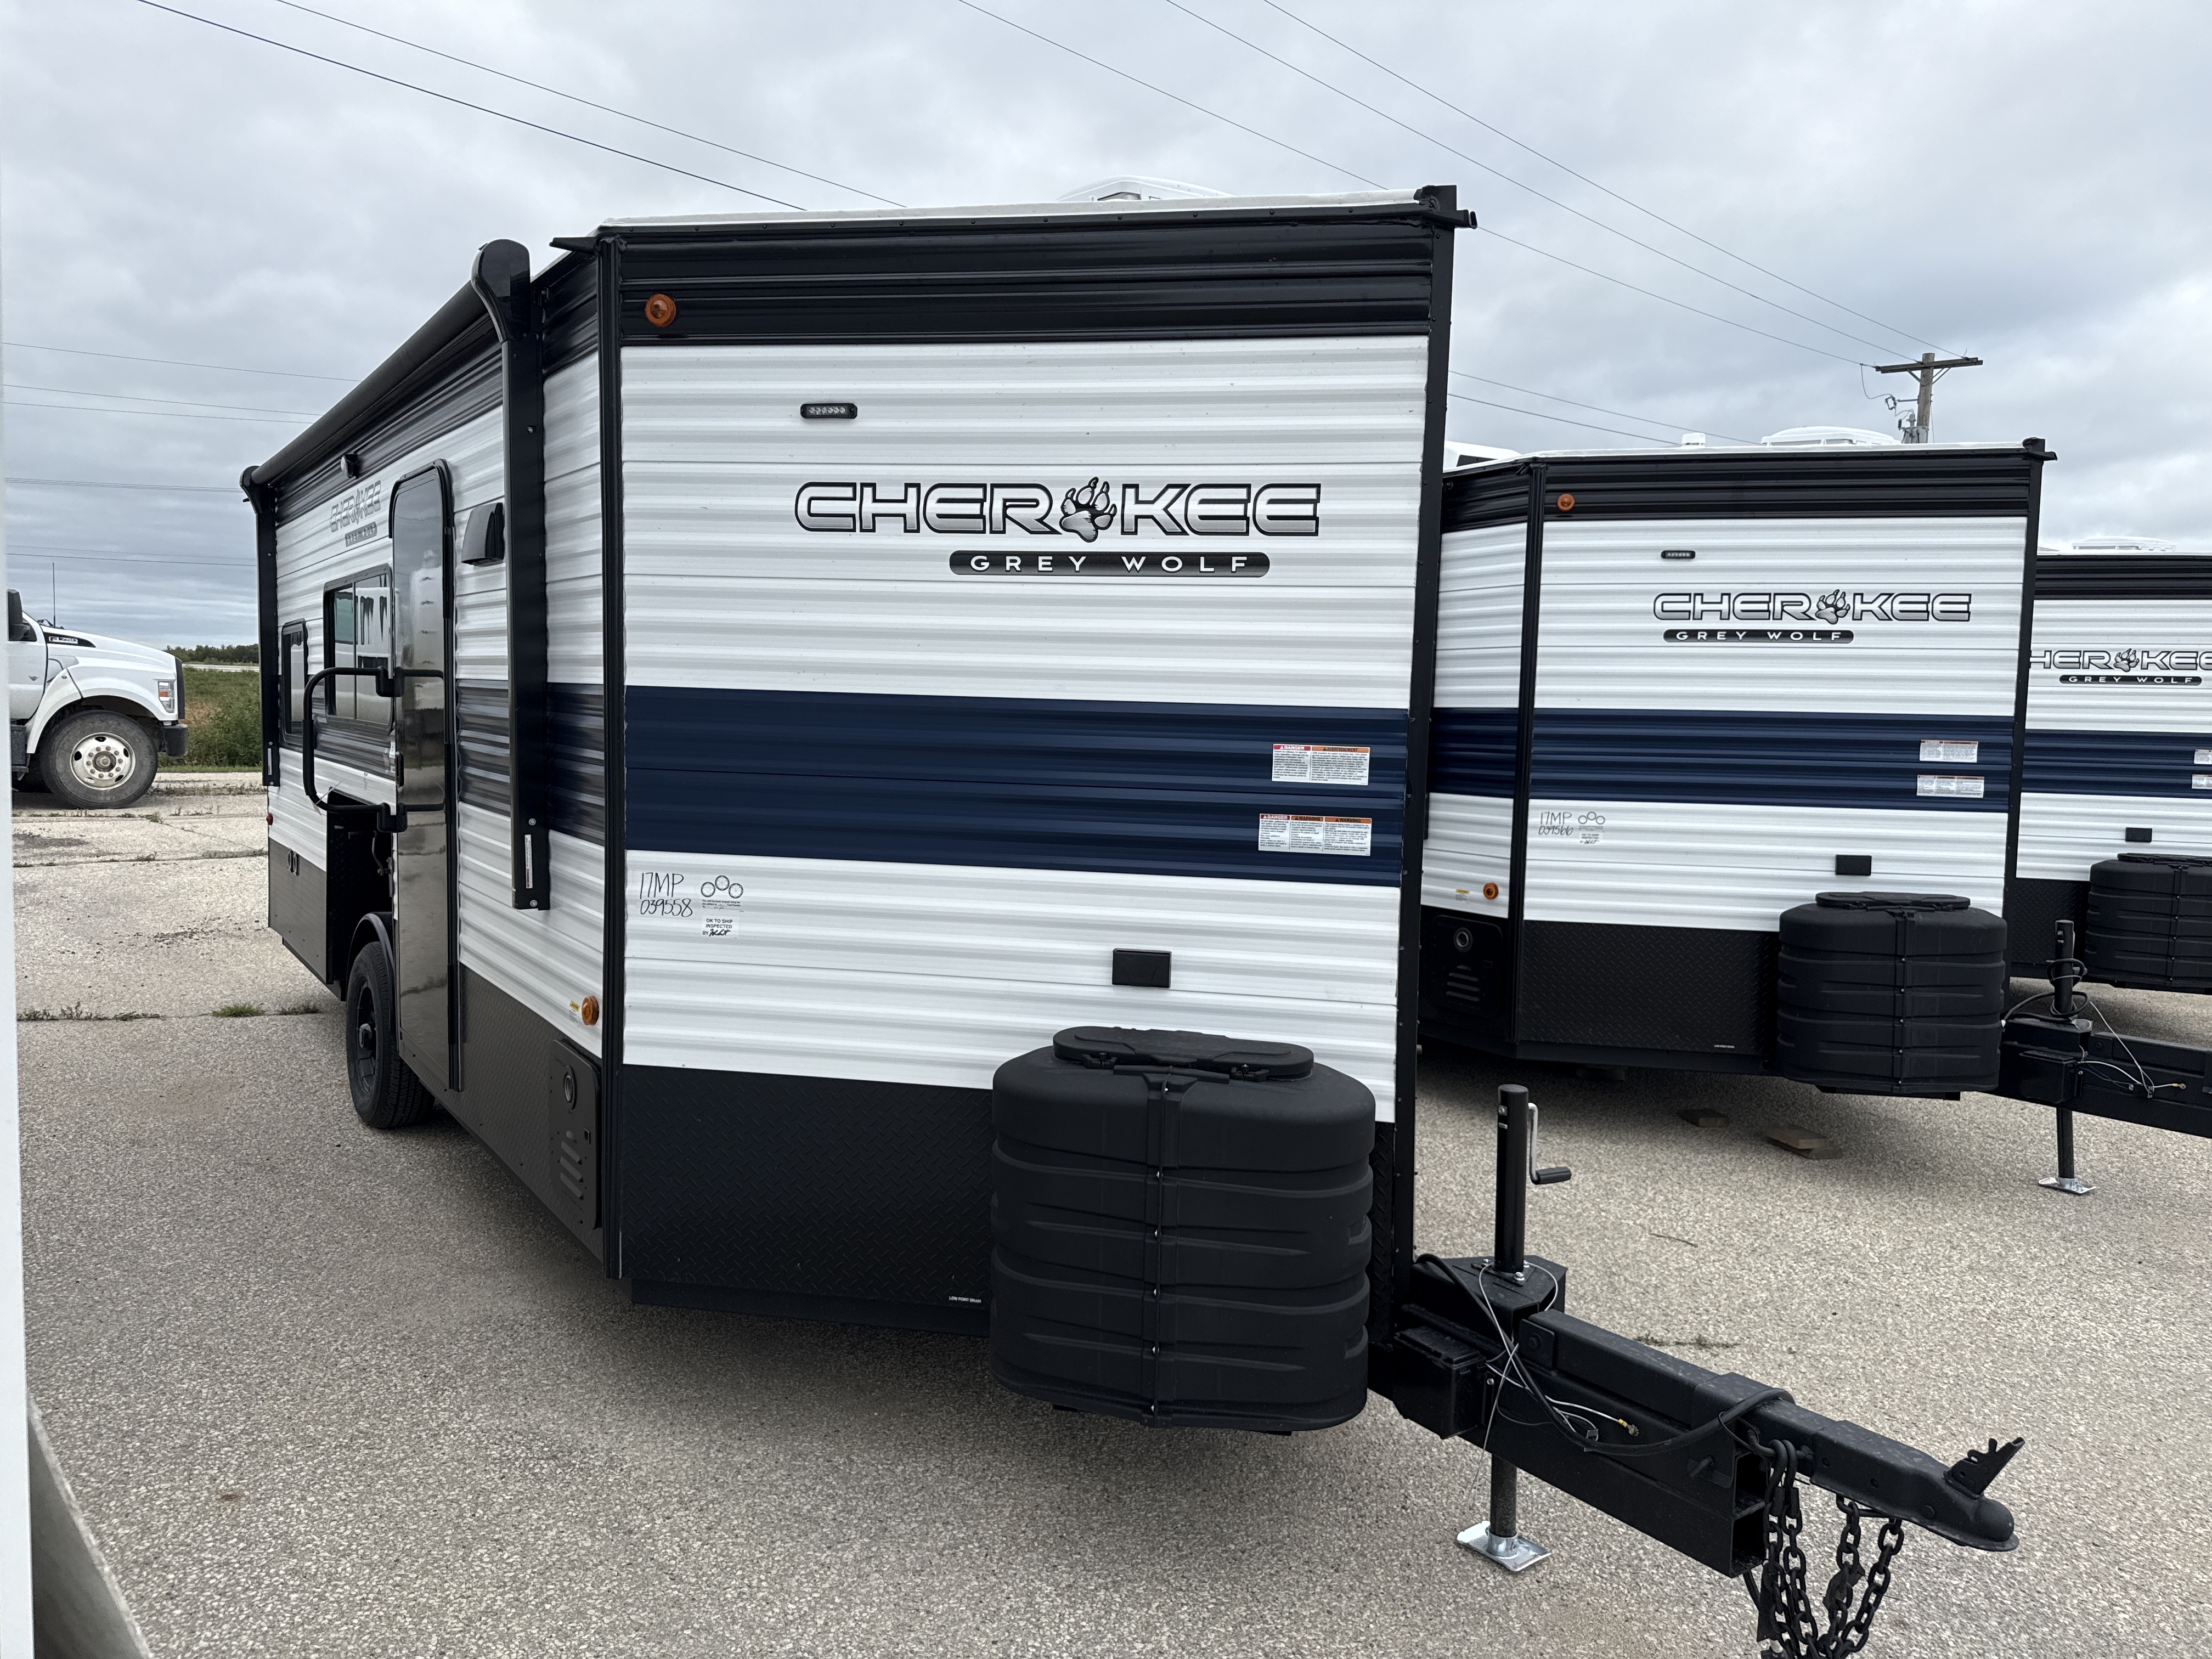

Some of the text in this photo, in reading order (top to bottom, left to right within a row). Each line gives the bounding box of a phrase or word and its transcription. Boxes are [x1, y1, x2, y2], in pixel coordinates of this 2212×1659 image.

[970, 554, 1248, 574] GREY WOLF
[1676, 630, 1842, 641] GREY WOLF
[640, 898, 693, 917] 039558
